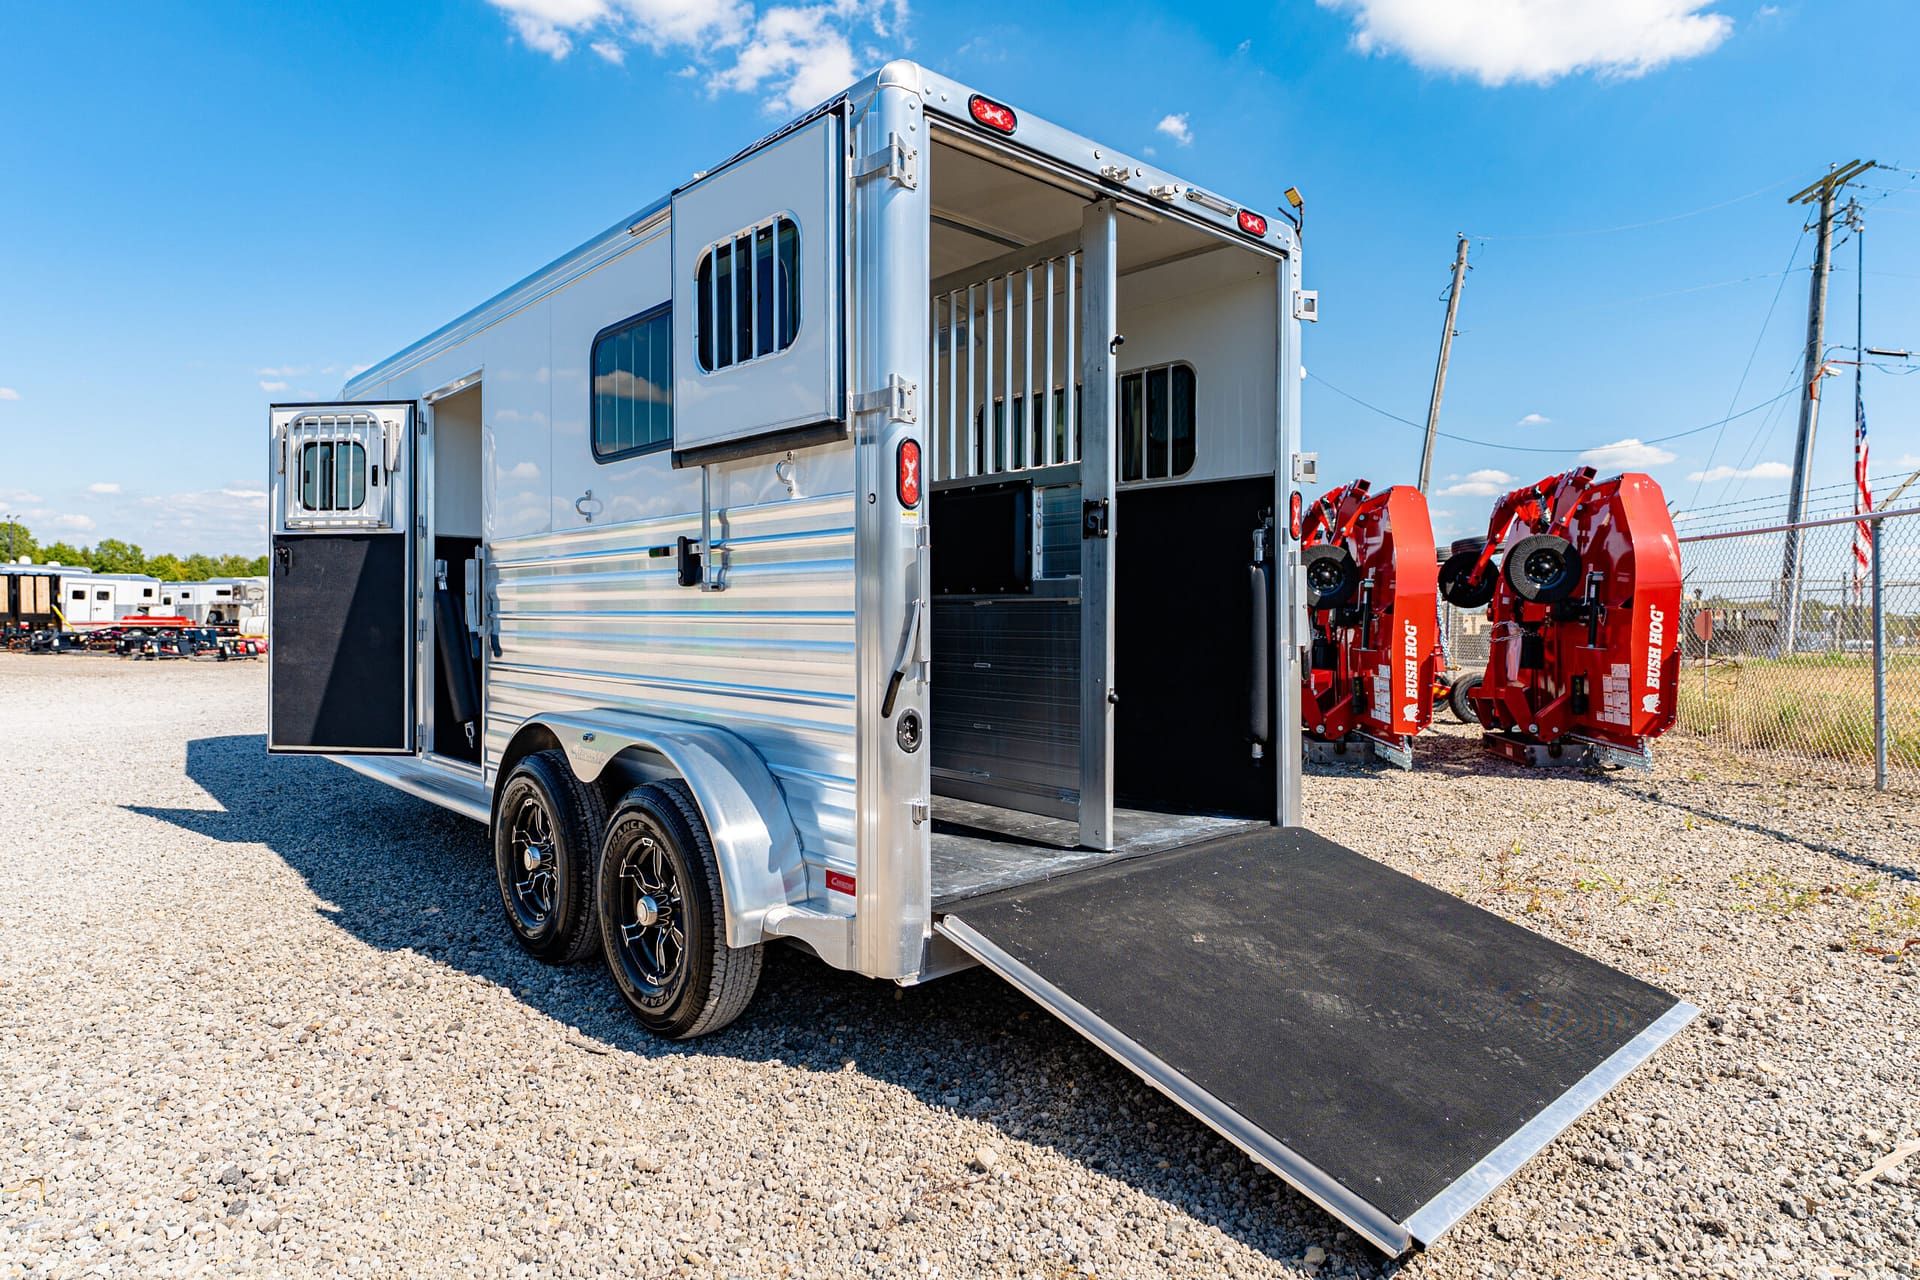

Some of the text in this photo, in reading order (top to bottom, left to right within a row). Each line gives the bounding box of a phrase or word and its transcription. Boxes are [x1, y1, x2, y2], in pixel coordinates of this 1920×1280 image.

[1405, 625, 1418, 699] BUSH HOG
[1646, 610, 1664, 689] BUSH HOG
